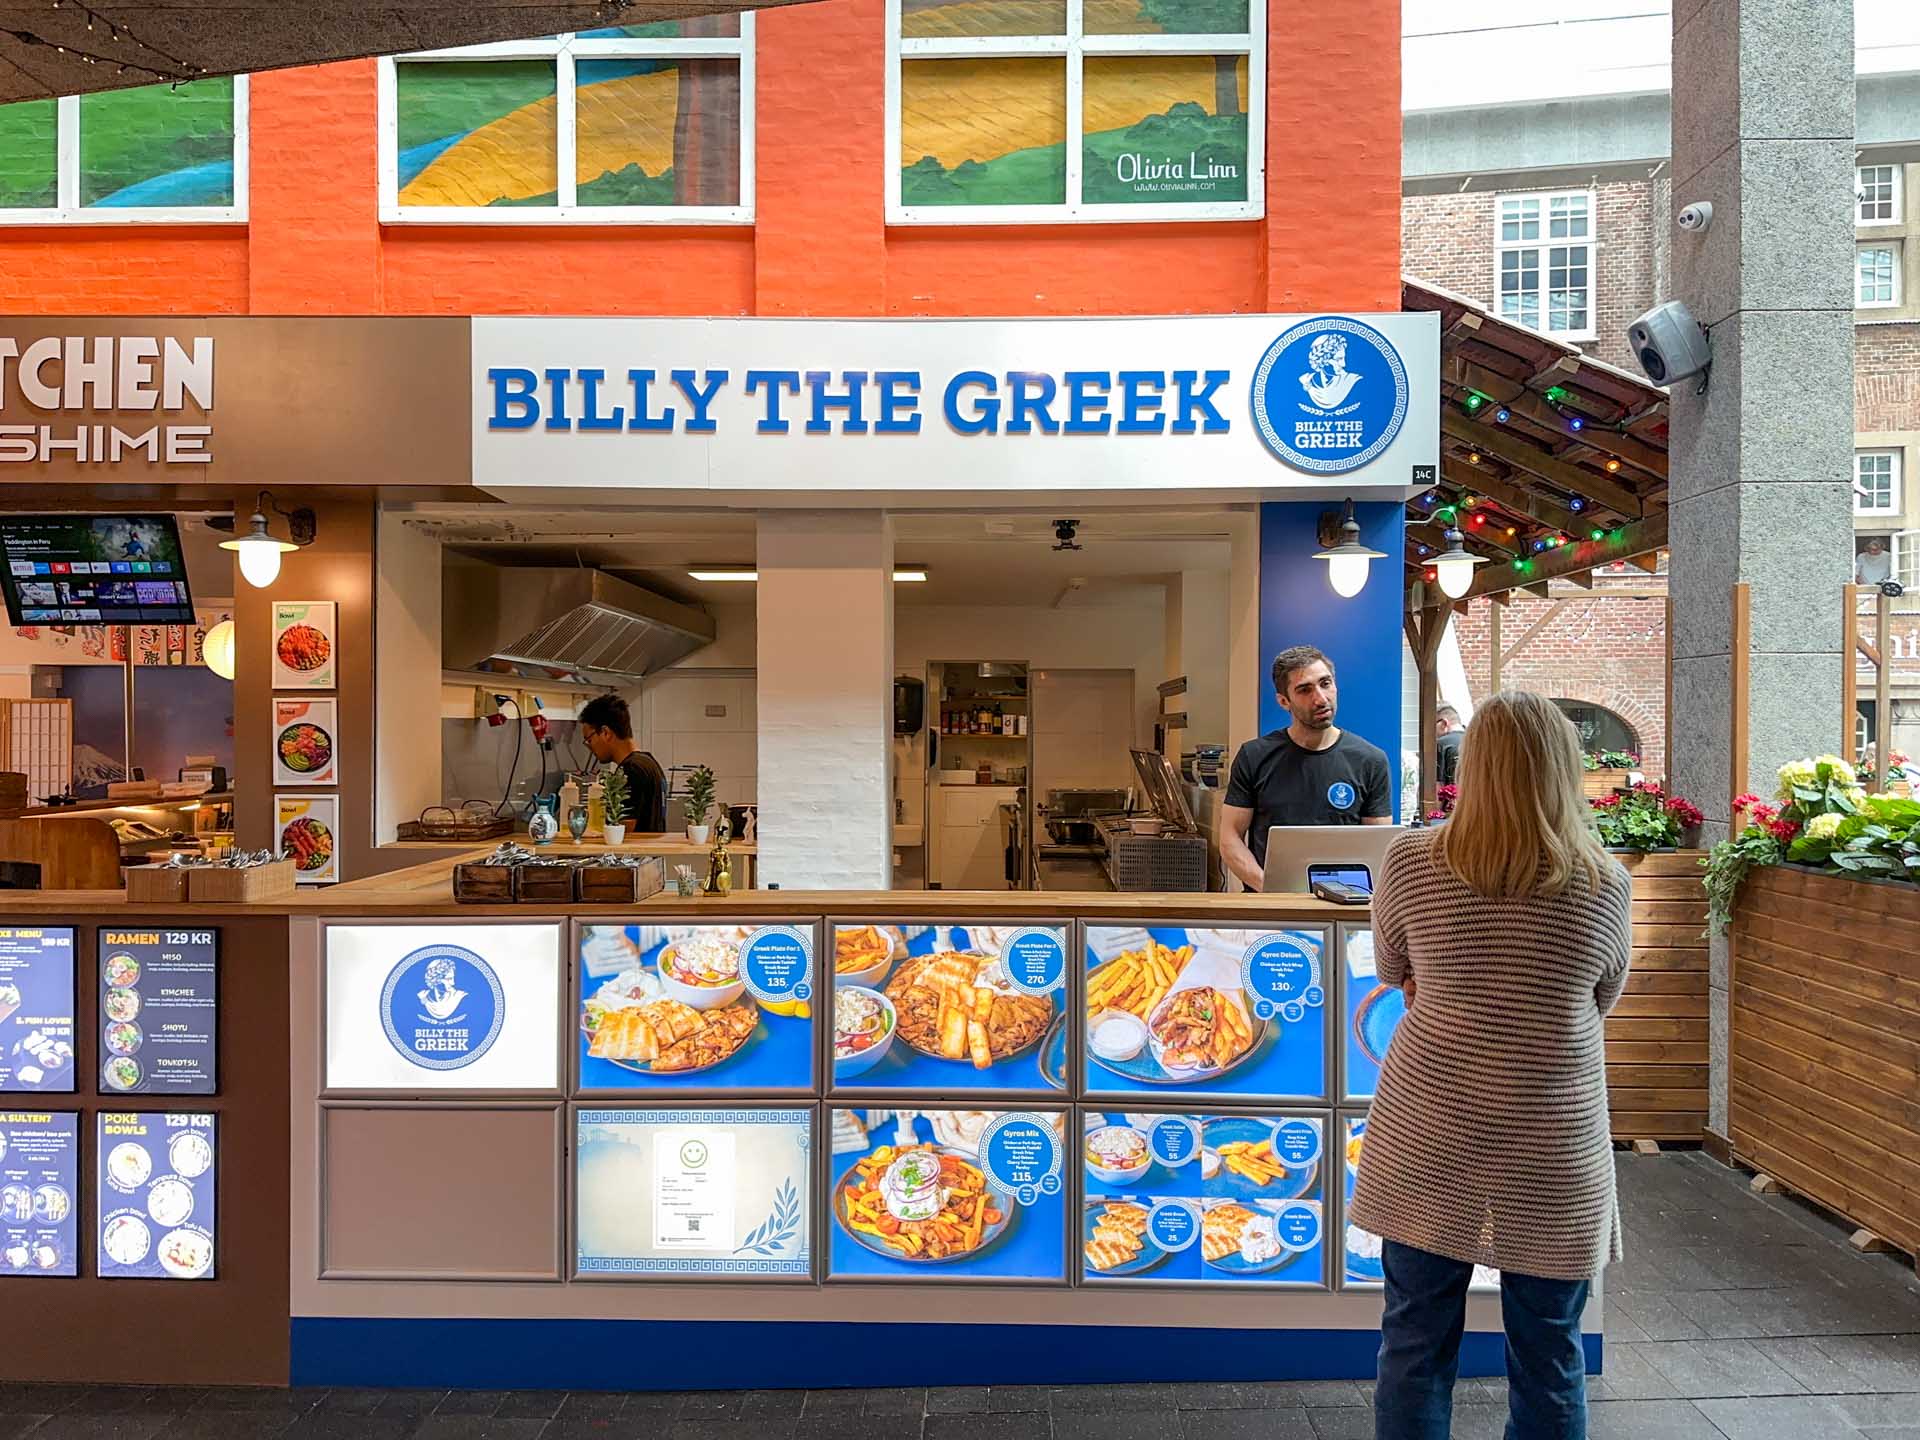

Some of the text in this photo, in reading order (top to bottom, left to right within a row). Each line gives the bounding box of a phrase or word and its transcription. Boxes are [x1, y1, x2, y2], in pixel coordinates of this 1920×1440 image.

[1117, 151, 1239, 182] Olivia Linn
[488, 368, 1231, 435] BILLY THE GREEK
[1295, 421, 1363, 432] BILLY THE
[0, 425, 212, 463] SHIME
[1295, 433, 1363, 448] GREEK
[1415, 470, 1432, 479] 14C
[106, 933, 212, 944] RAMEN 129 KR
[162, 953, 182, 961] MISO
[415, 1029, 469, 1038] BILLY THE
[415, 1038, 469, 1050] GREEK
[165, 1115, 188, 1127] 129
[190, 1115, 212, 1127] KR
[105, 1125, 147, 1135] BOWLS
[1003, 1130, 1024, 1138] Gyros
